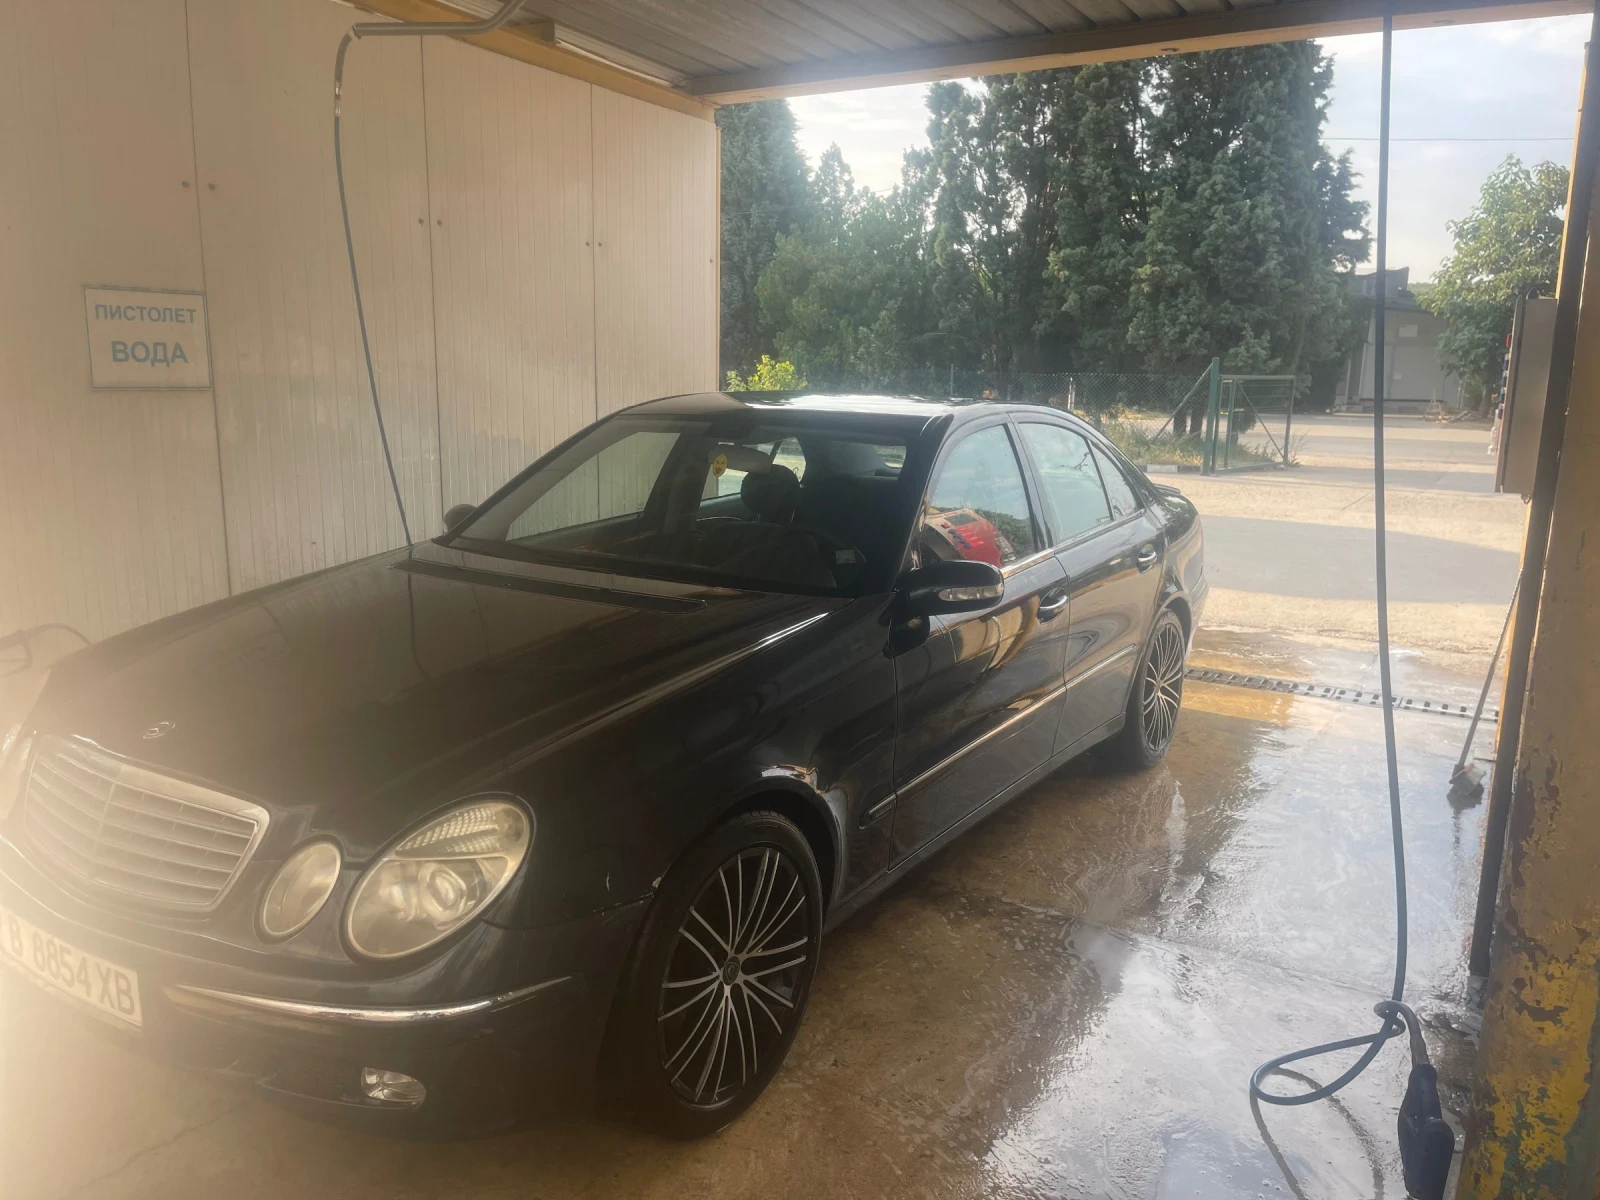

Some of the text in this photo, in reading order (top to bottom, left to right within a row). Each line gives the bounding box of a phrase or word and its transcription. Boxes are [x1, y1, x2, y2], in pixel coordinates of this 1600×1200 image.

[94, 304, 197, 324] ПИСТОЛЕТ
[111, 340, 189, 368] ВОДА
[32, 931, 92, 999] 8854
[95, 961, 135, 1016] XB
